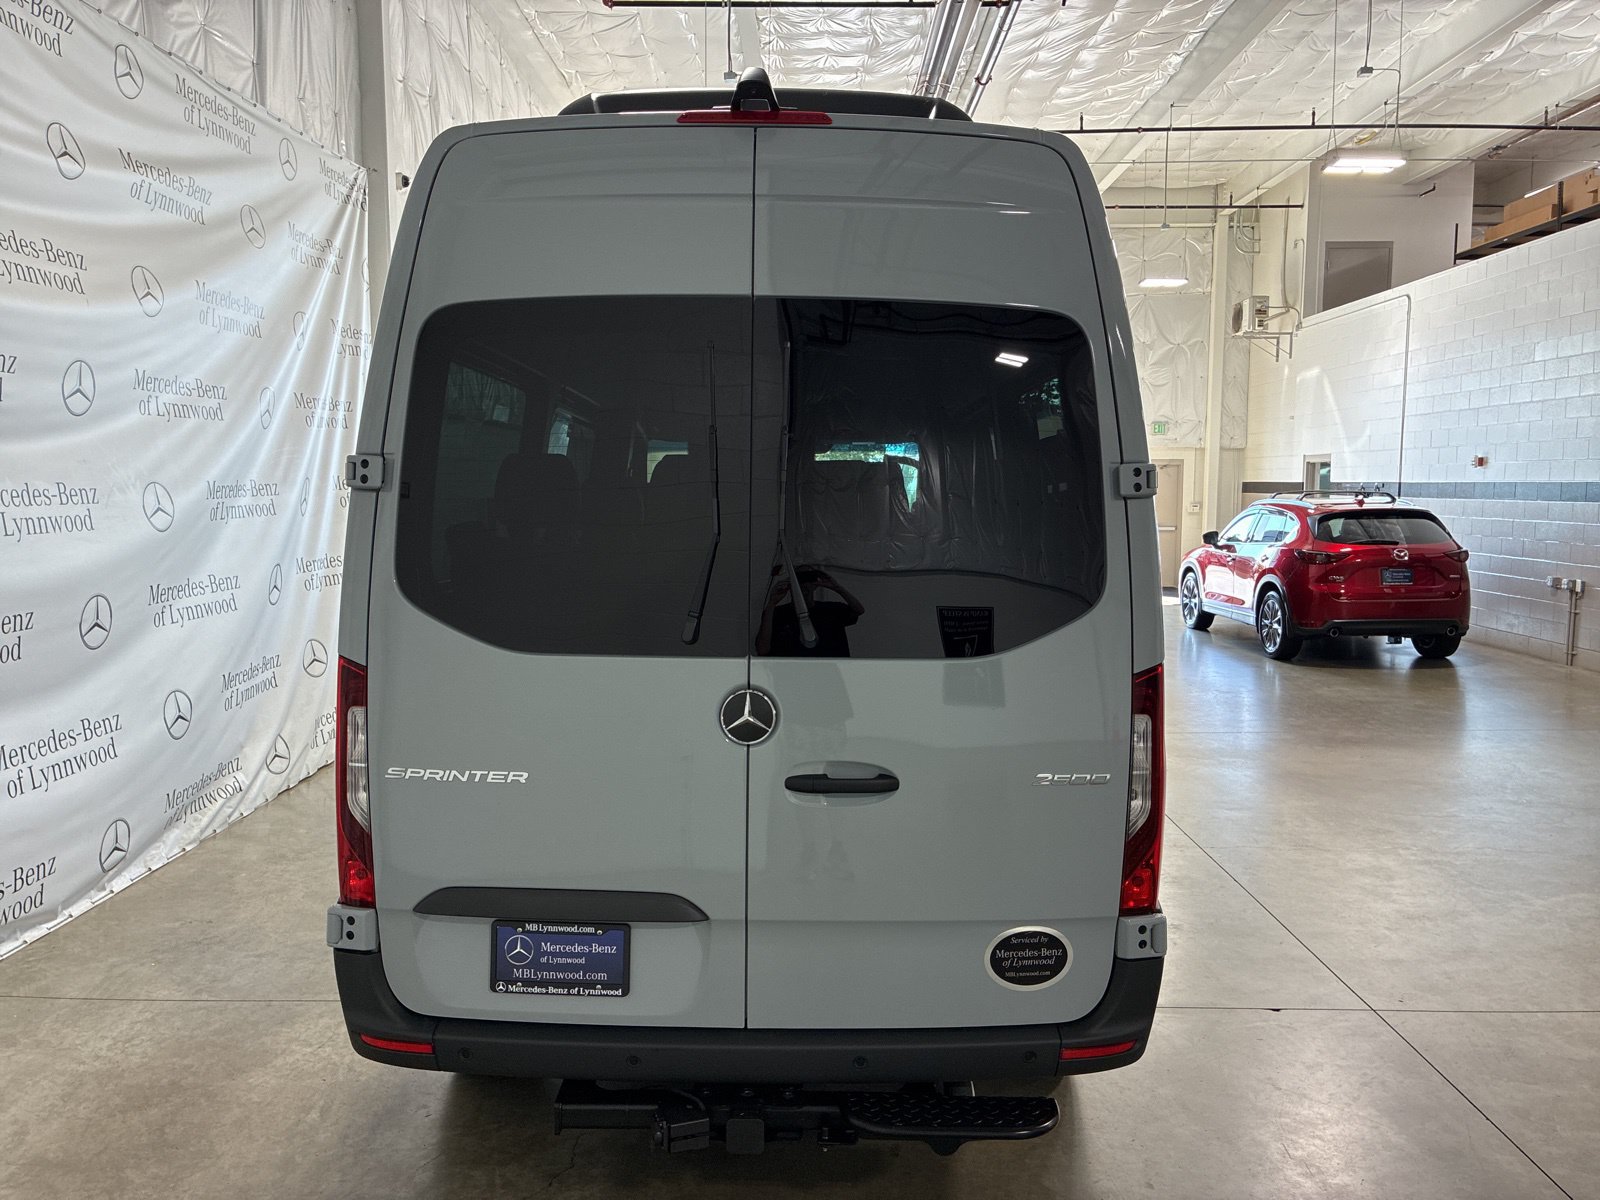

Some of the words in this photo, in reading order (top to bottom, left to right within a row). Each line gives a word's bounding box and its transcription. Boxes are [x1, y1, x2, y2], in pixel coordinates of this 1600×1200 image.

[175, 73, 256, 136] Mercedes-Benz
[184, 105, 195, 125] of
[198, 108, 251, 154] Lynnwood
[118, 148, 213, 206] Mercedes-Benz
[130, 179, 145, 200] of
[145, 182, 206, 225] Lynnwood
[0, 259, 86, 295] ynnwood
[195, 279, 265, 320] Mercedes-Benz
[200, 306, 211, 325] of
[212, 308, 262, 339] Lynnwood
[133, 368, 228, 400] Mercedes-Benz
[139, 395, 152, 416] of
[155, 396, 224, 422] Lynnwood
[1154, 423, 1166, 434] EXIT
[0, 482, 100, 507] cedes-Benz
[206, 479, 279, 500] Mercedes-Benz
[0, 508, 95, 542] Lynnwood
[209, 502, 220, 521] of
[220, 499, 277, 525] Lynnwood
[148, 573, 240, 606] Mercedes-Benz
[304, 574, 315, 592] of
[153, 605, 166, 628] of
[168, 593, 238, 628] Lynnwood
[221, 654, 281, 693] Mercedes-Benz
[224, 690, 235, 711] of
[235, 671, 278, 709] Lynnwood
[7, 769, 25, 799] of
[27, 736, 118, 793] Lynnwood
[385, 767, 529, 783] SPRINTER
[164, 757, 242, 814] Mercedes-Benz
[541, 942, 617, 954] Mercedes-Benz
[996, 948, 1063, 959] Mercedes-Benz
[1010, 936, 1040, 944] Serviced
[1041, 935, 1049, 944] by
[513, 968, 608, 980] MBLynnwood.com
[540, 956, 548, 964] of
[549, 956, 586, 965] Lynnwood
[1002, 958, 1013, 968] of
[1013, 956, 1056, 968] Lynnwood
[508, 985, 568, 995] Mercedes-Benz
[570, 987, 578, 995] of
[580, 987, 622, 997] Lynnwood
